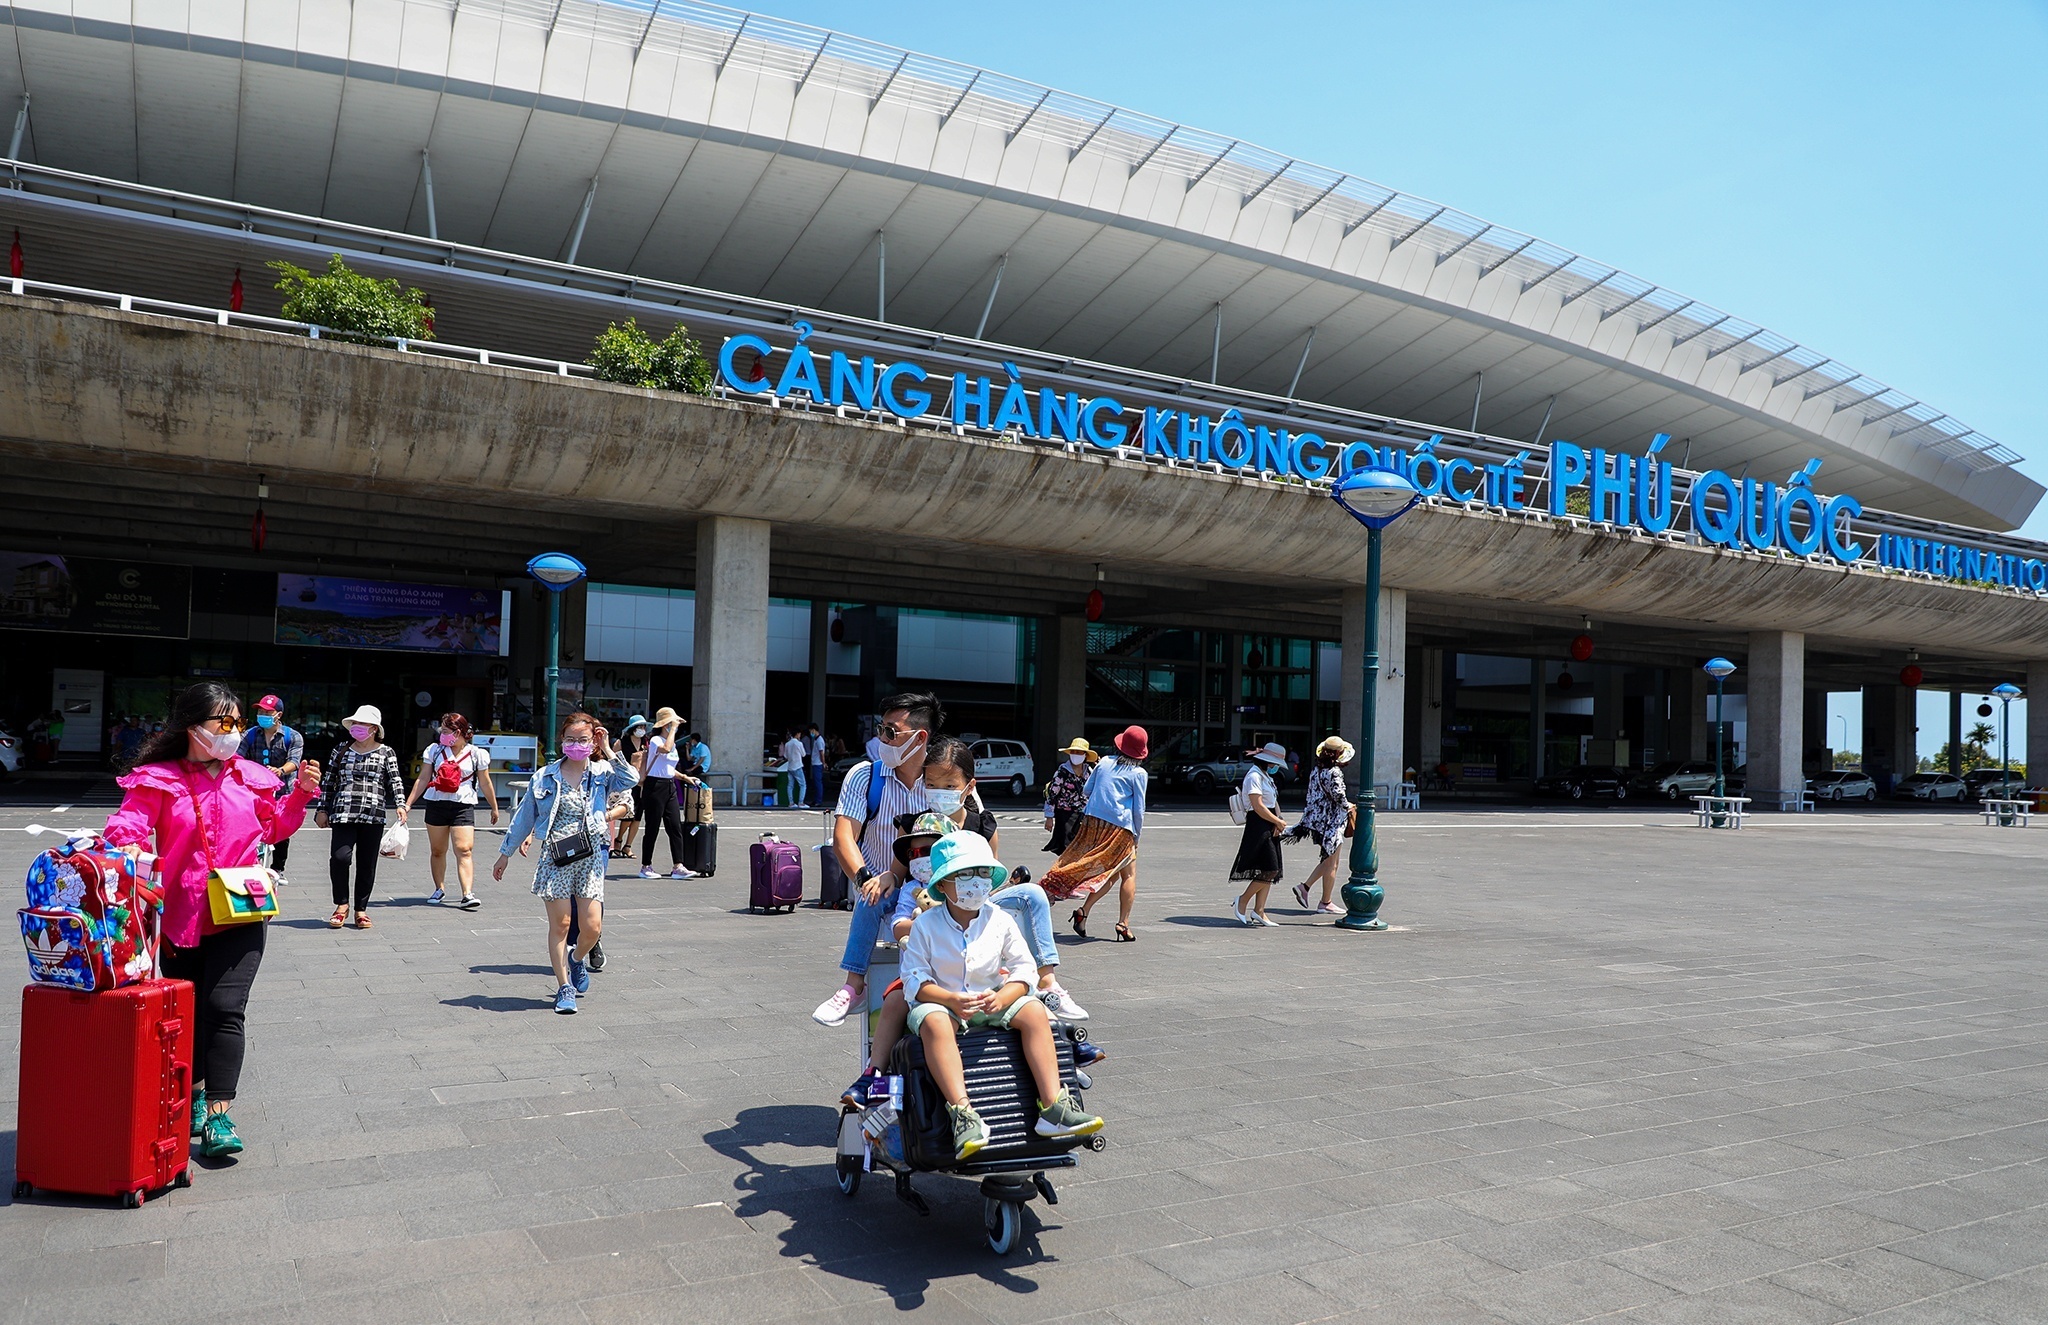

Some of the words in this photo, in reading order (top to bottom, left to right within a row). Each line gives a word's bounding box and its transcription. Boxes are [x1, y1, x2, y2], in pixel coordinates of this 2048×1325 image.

[718, 320, 932, 418] CẢNG
[953, 361, 1128, 449] HÀNG
[1144, 406, 1330, 479] KHÔNG
[1484, 450, 1531, 510] TẾ
[1550, 433, 1672, 533] PHÚ
[1692, 458, 1863, 563] QUỐC
[1879, 533, 2048, 591] INTERNATIO
[420, 590, 444, 599] XANH
[32, 964, 75, 977] adidas
